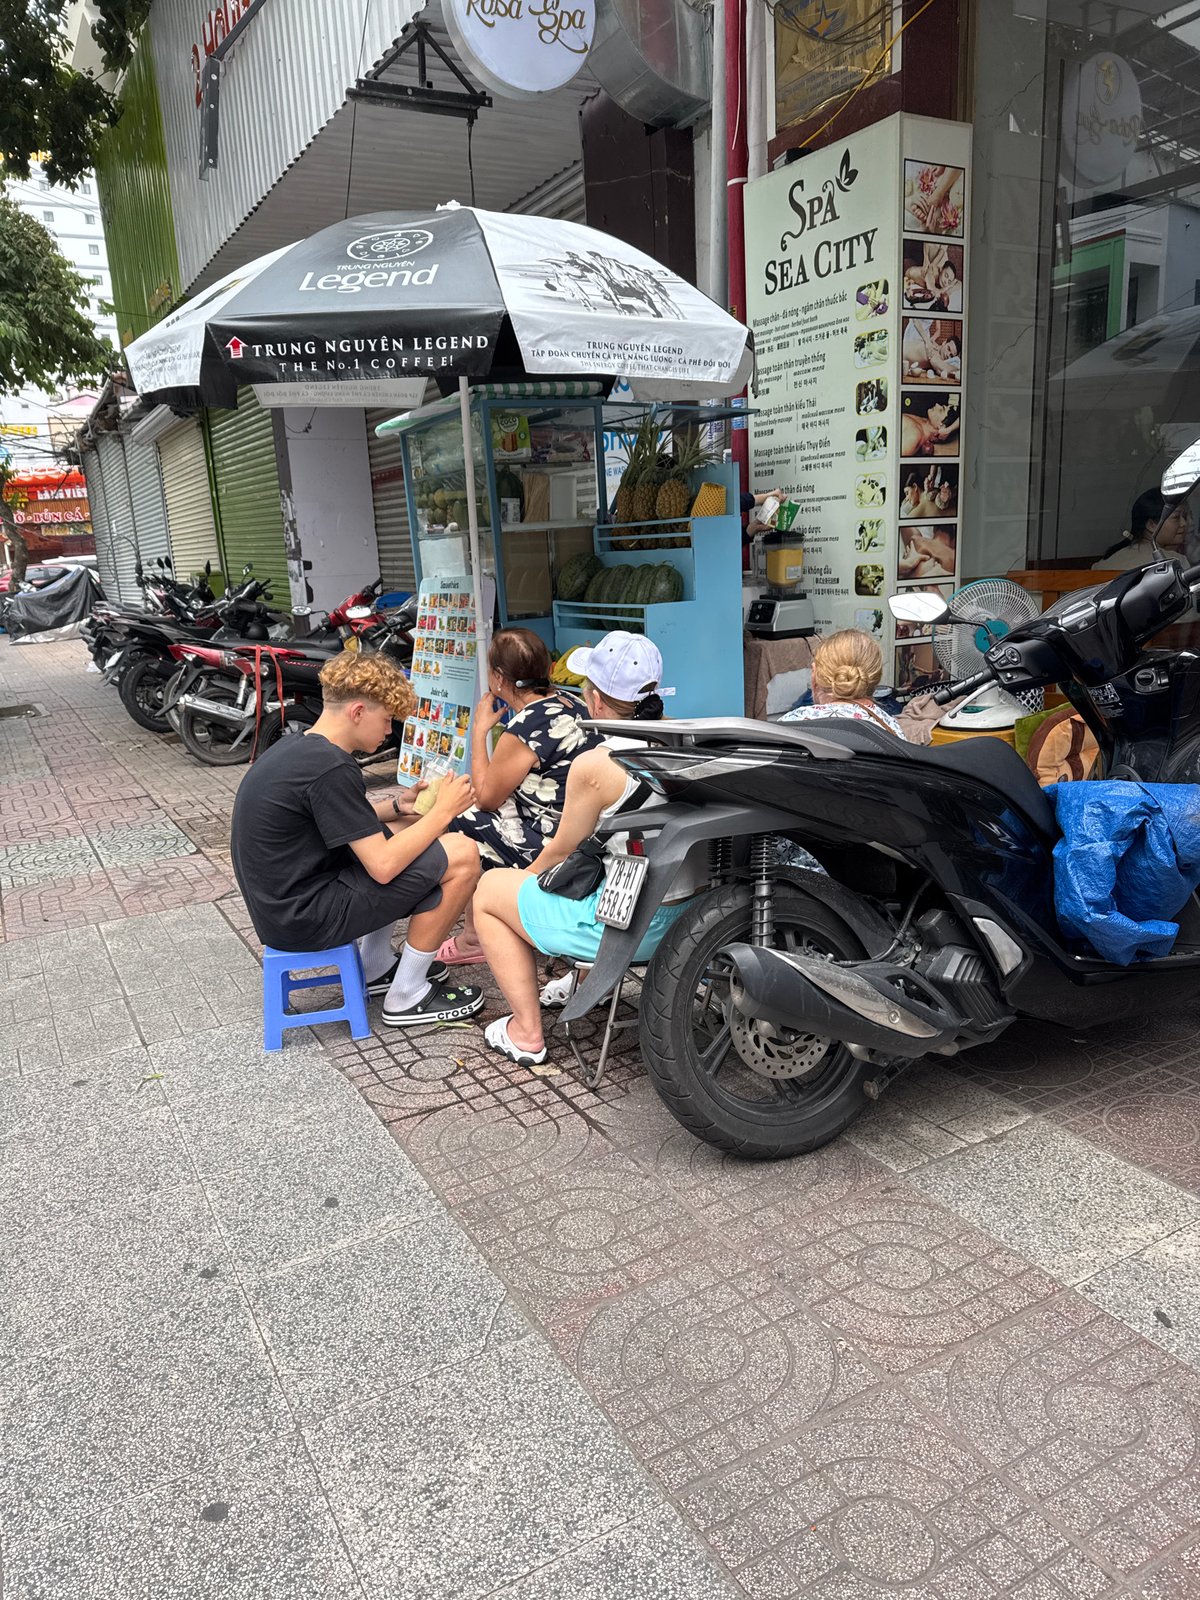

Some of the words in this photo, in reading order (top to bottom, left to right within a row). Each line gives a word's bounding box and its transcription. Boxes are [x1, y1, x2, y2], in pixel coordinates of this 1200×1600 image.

[336, 263, 371, 271] TRUNG
[373, 260, 415, 269] NGUYÊN
[764, 254, 810, 295] SEA
[813, 227, 878, 279] CITY
[299, 264, 439, 294] Legend
[753, 316, 769, 329] Massage
[252, 341, 316, 357] TRUNG
[325, 336, 403, 353] NGUYÊN
[413, 335, 489, 351] LEGEND
[587, 341, 615, 350] TRUNG
[617, 343, 651, 352] NGUYÊN
[653, 345, 683, 355] LEGEND
[279, 361, 318, 373] THE
[371, 355, 454, 369] COFFEE!
[773, 362, 782, 372] toàn
[773, 404, 783, 414] toàn
[754, 448, 772, 459] Massage
[774, 445, 784, 454] toàn
[610, 859, 640, 890] 78-H1
[598, 888, 633, 922] 558.43
[437, 1004, 474, 1020] crocs
